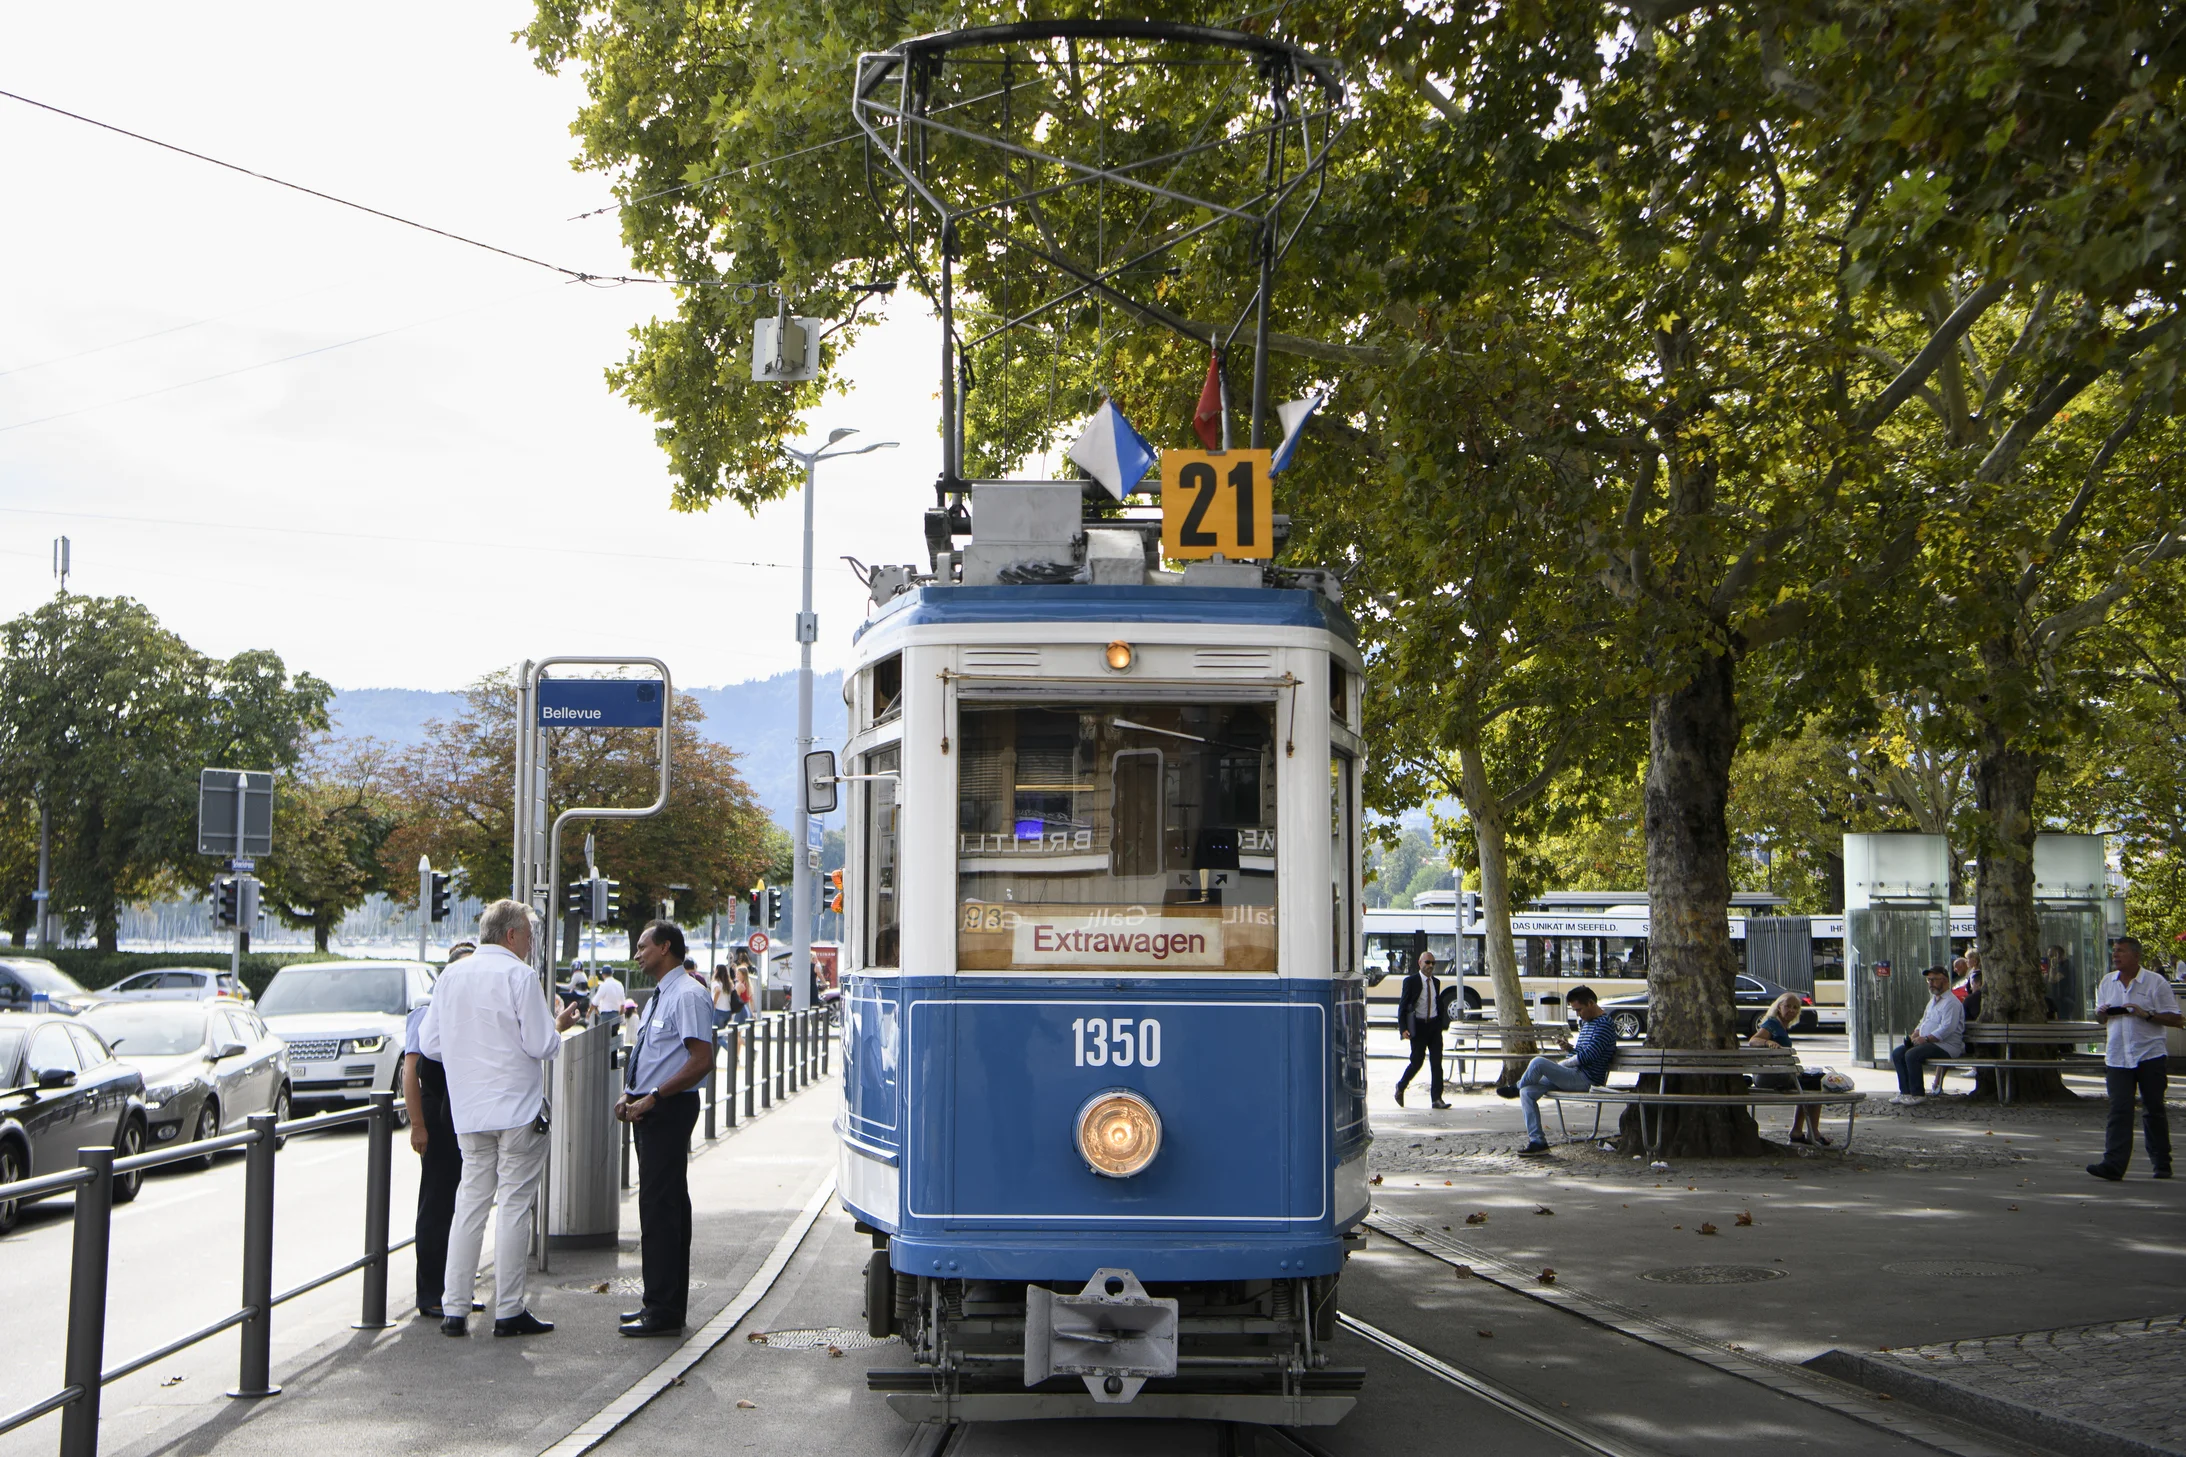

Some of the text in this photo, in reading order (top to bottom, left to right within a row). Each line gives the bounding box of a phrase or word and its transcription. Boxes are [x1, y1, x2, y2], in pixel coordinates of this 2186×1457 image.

[1179, 462, 1254, 547] 21
[543, 706, 602, 719] Bellevue
[1034, 925, 1205, 960] Extrawagen
[1512, 922, 1619, 932] DAS UNIKAT IM SEEFELD.
[1072, 1018, 1161, 1067] 1350
